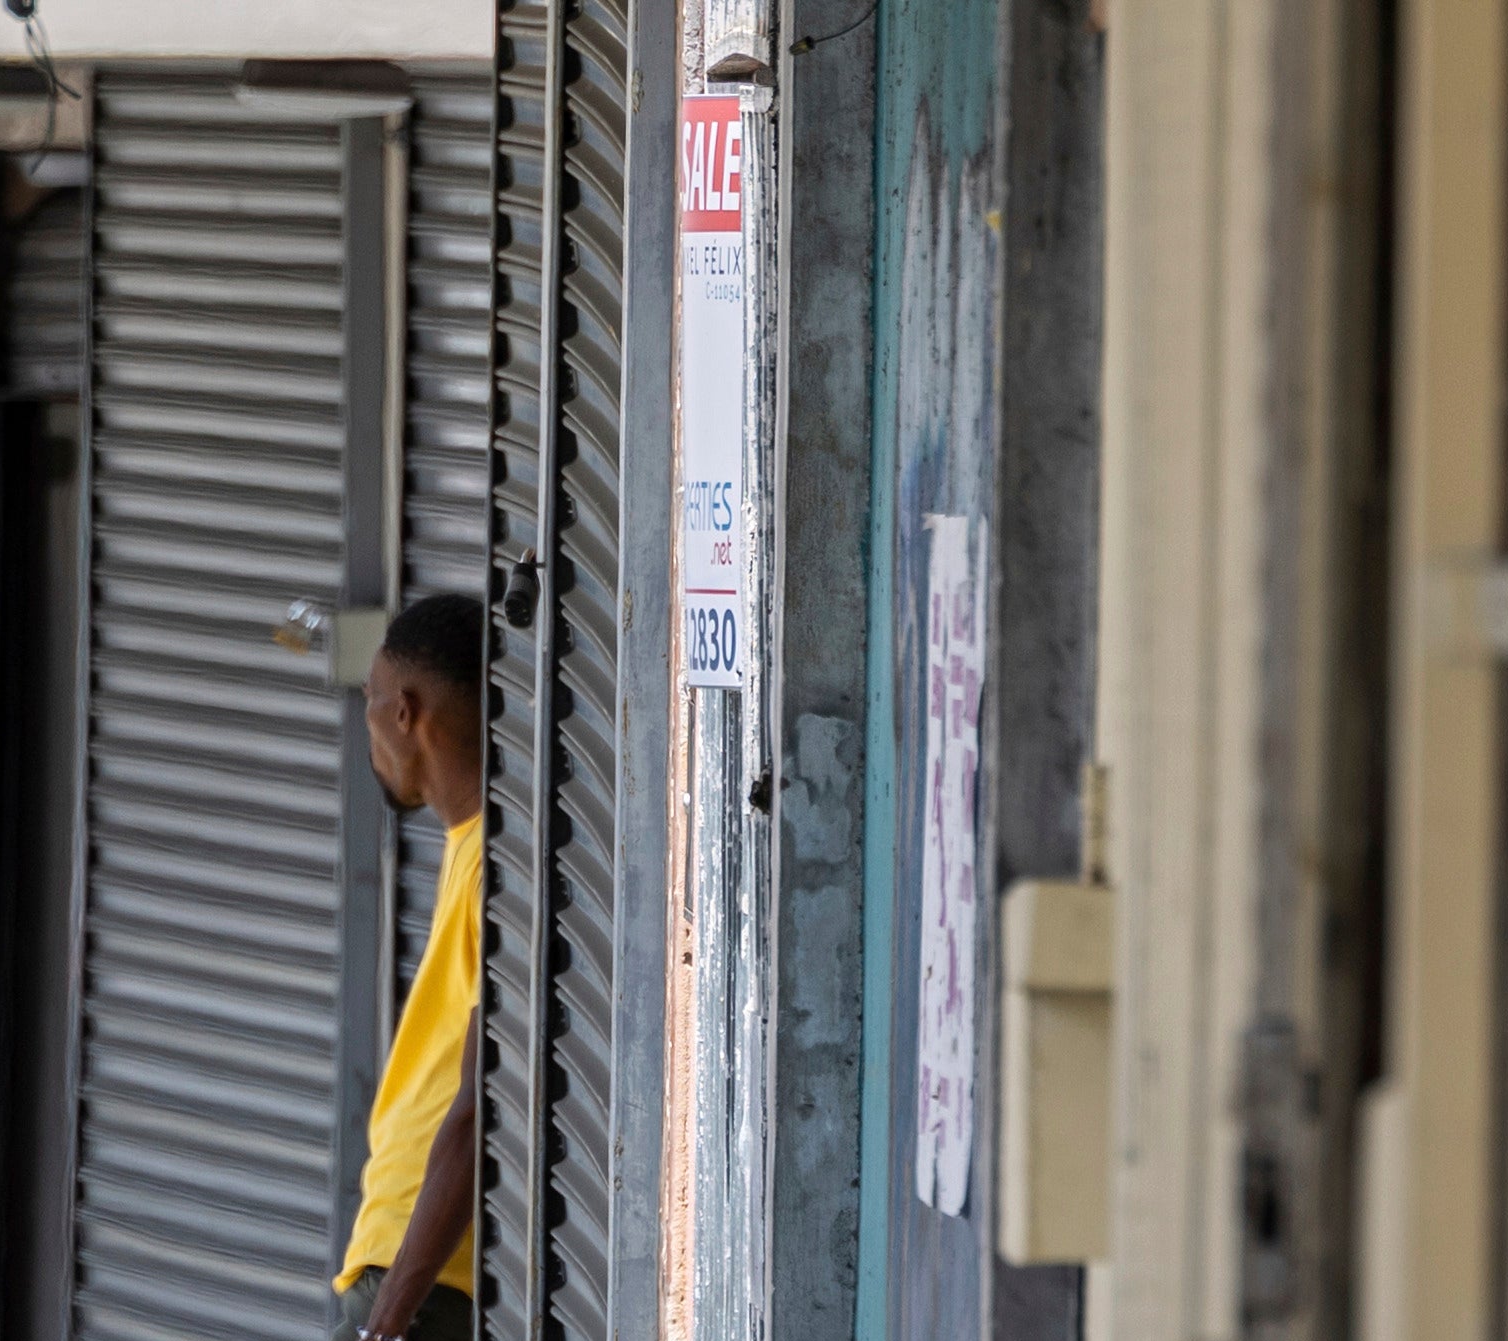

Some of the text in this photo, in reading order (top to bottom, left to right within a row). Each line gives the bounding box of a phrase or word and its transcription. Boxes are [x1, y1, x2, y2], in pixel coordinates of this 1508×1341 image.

[682, 121, 742, 211] SALE
[704, 238, 742, 276] FÉLIX
[705, 280, 741, 304] C-11054
[710, 534, 732, 566] .net
[686, 607, 737, 672] 2830
